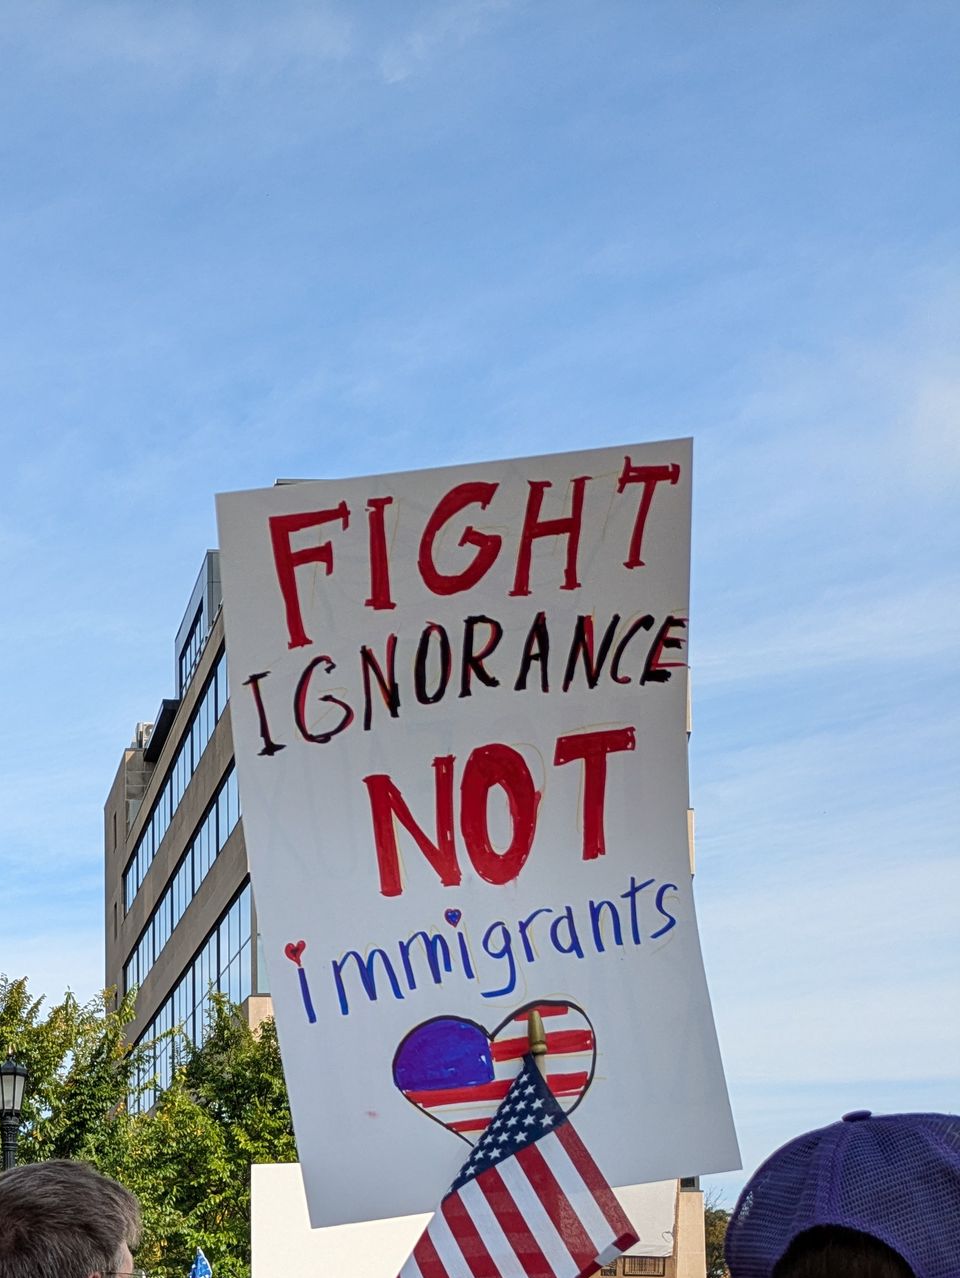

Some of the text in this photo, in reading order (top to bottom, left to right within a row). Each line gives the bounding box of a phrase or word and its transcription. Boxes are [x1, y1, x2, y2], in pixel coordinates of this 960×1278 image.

[269, 456, 680, 649] FIGHT
[243, 611, 689, 756] IGNORANCE
[362, 727, 636, 897] NOT
[285, 876, 679, 1024] immigrants
